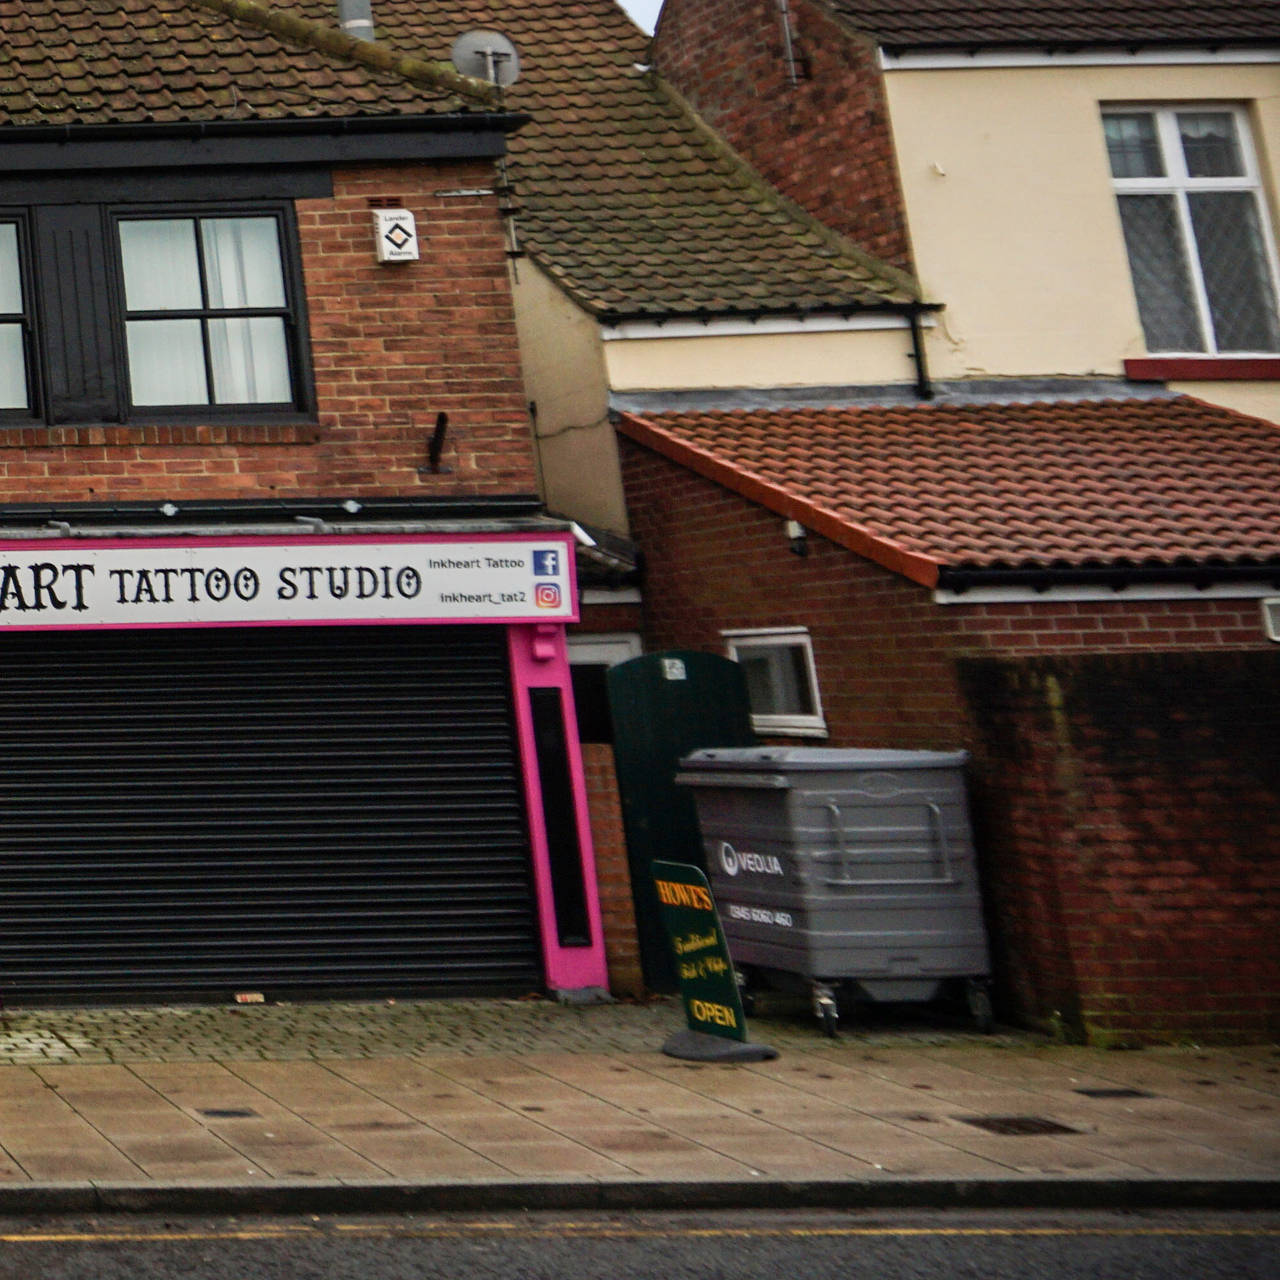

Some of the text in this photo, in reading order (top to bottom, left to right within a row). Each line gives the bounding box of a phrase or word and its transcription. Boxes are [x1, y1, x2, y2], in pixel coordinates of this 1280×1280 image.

[429, 557, 525, 569] Inkheart Tattoo
[109, 567, 261, 604] TATTOO
[277, 565, 422, 600] STUDIO
[440, 591, 526, 604] inkheart_tat2
[737, 853, 784, 876] VEOLIA
[692, 999, 737, 1028] OPEN
